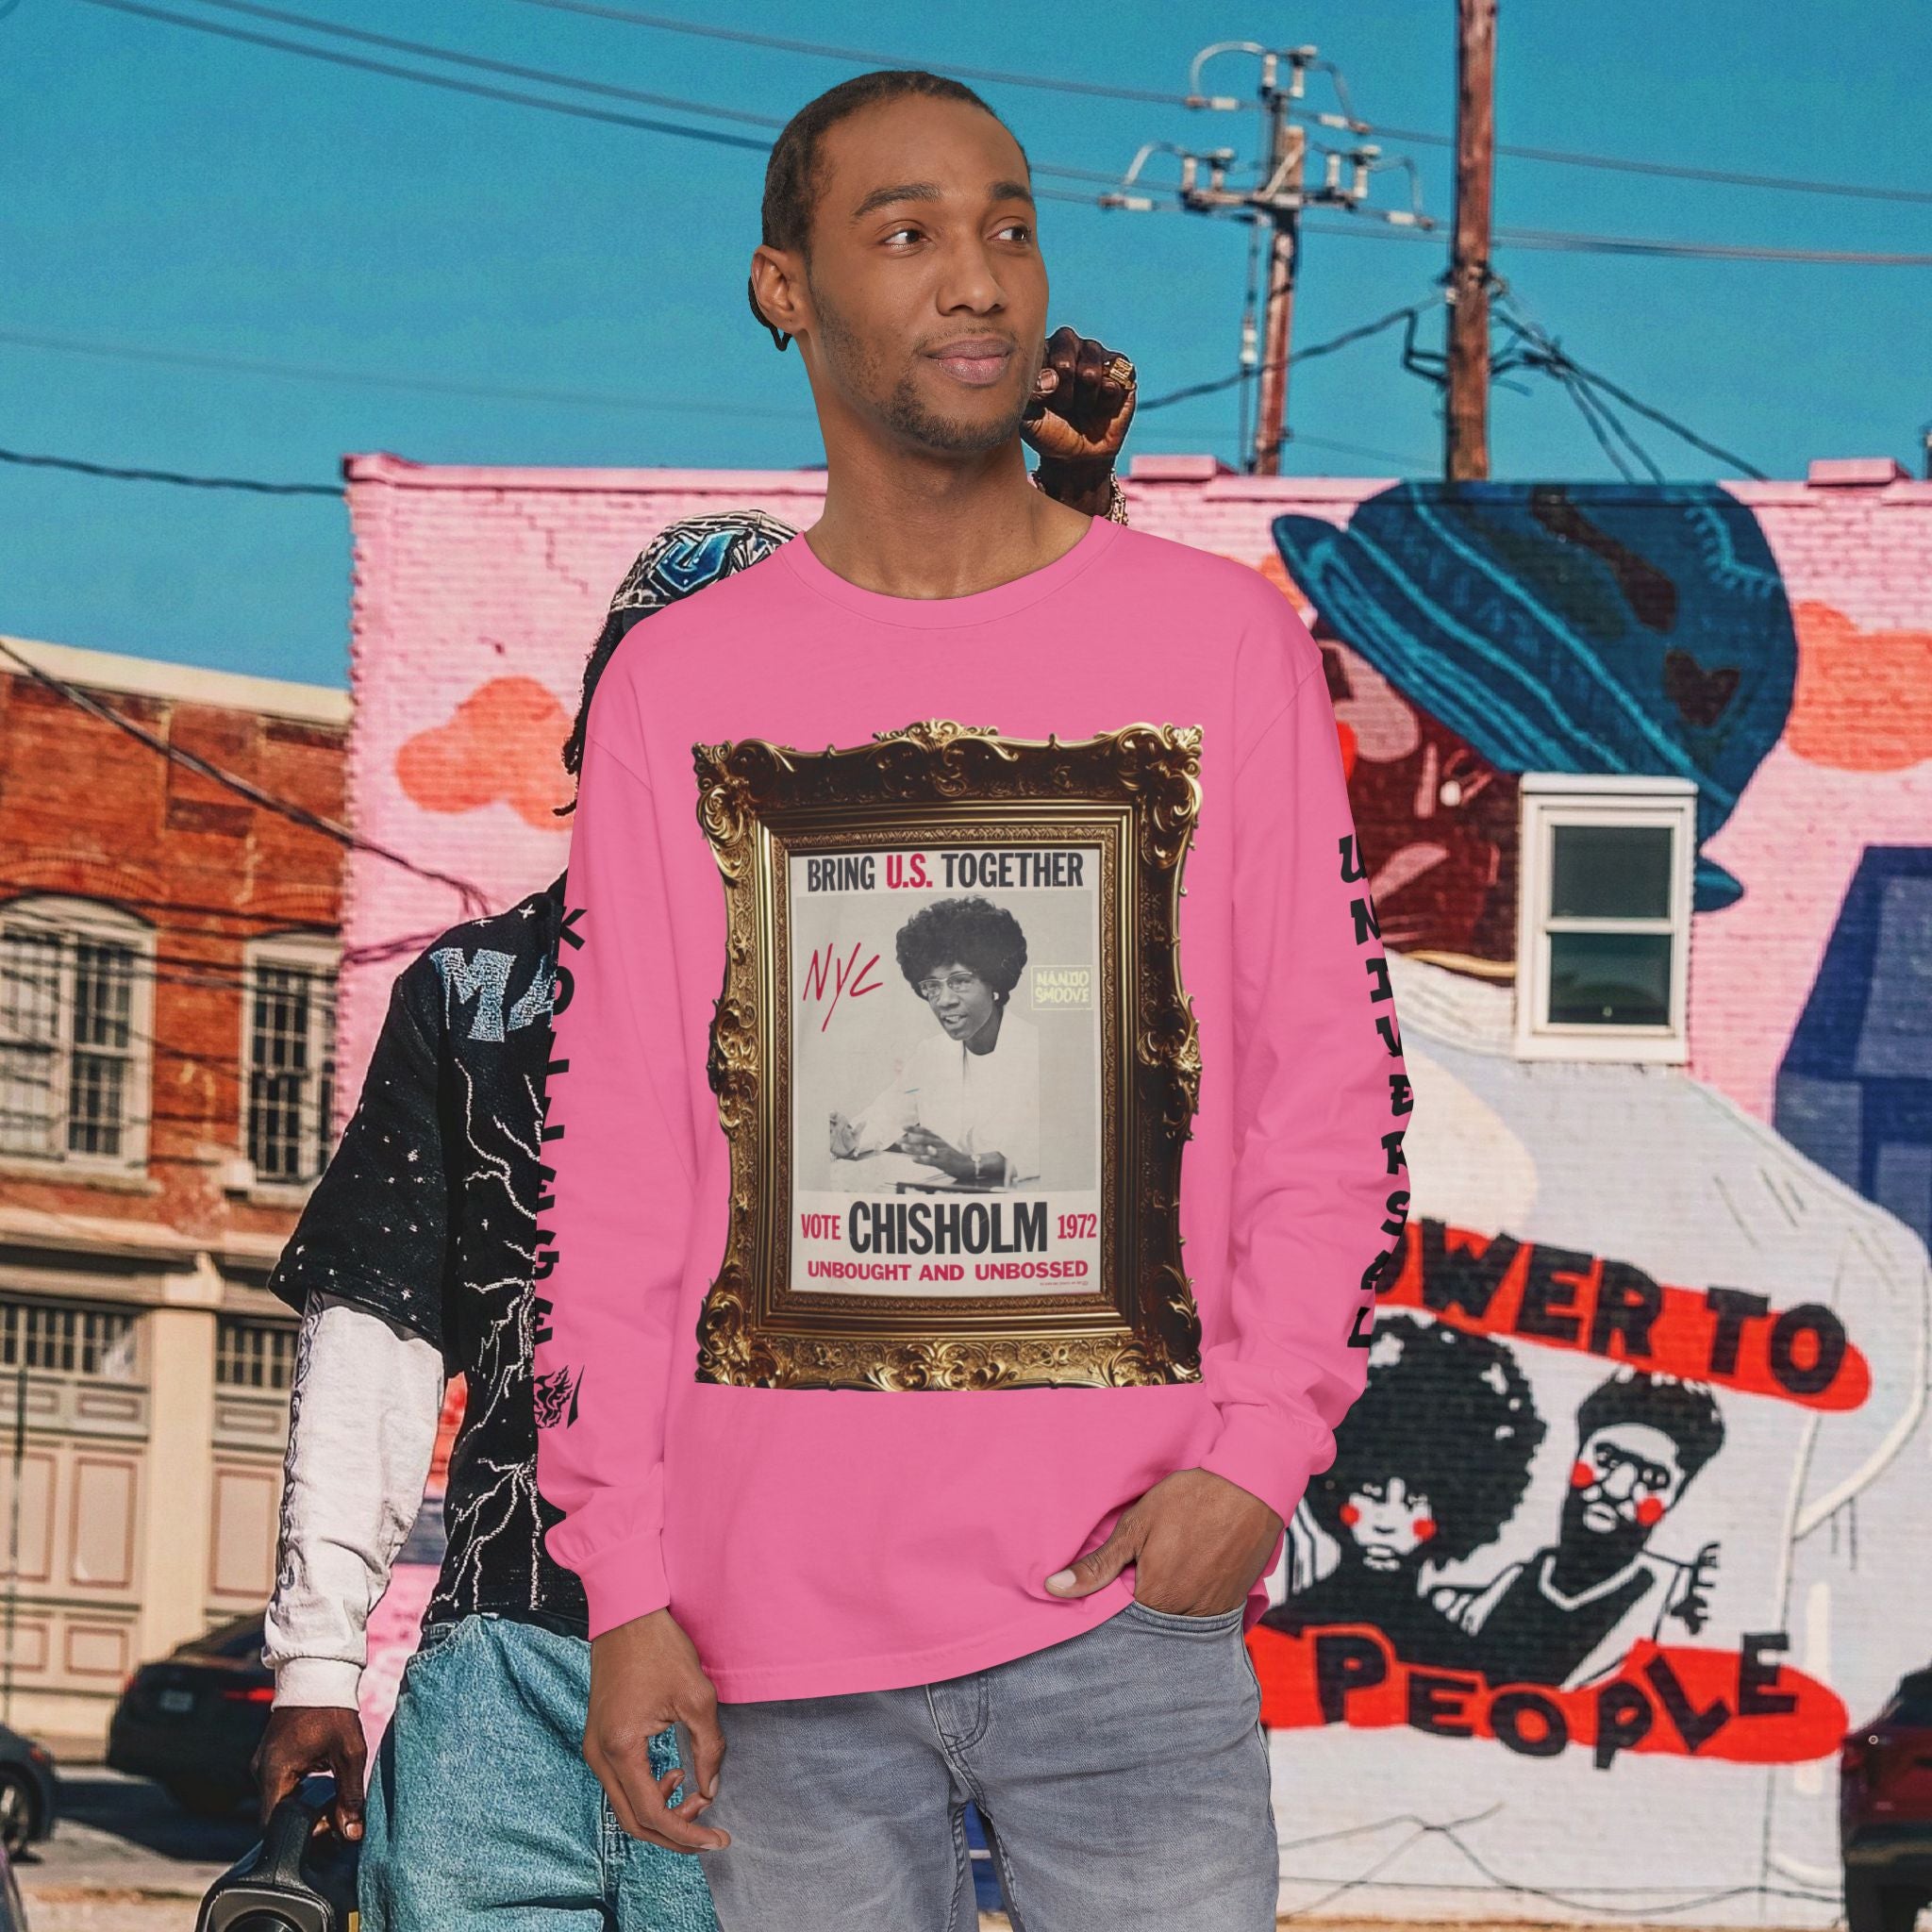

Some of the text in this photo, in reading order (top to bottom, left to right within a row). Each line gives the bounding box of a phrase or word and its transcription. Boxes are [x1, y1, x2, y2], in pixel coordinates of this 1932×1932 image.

[808, 852, 1084, 892] BRING U.S. TOGETHER
[803, 941, 883, 1032] NYC
[1035, 986, 1089, 1004] SMOOVE
[1037, 970, 1089, 987] NANDO
[1338, 833, 1414, 1348] UNIVERSAL
[801, 1201, 1097, 1255] VOTE CHISHOLM 1972
[808, 1260, 1089, 1281] UNBOUGHT AND UNBOSSED
[1705, 1286, 1846, 1394] TO
[1313, 1632, 1798, 1771] PEOPLE
